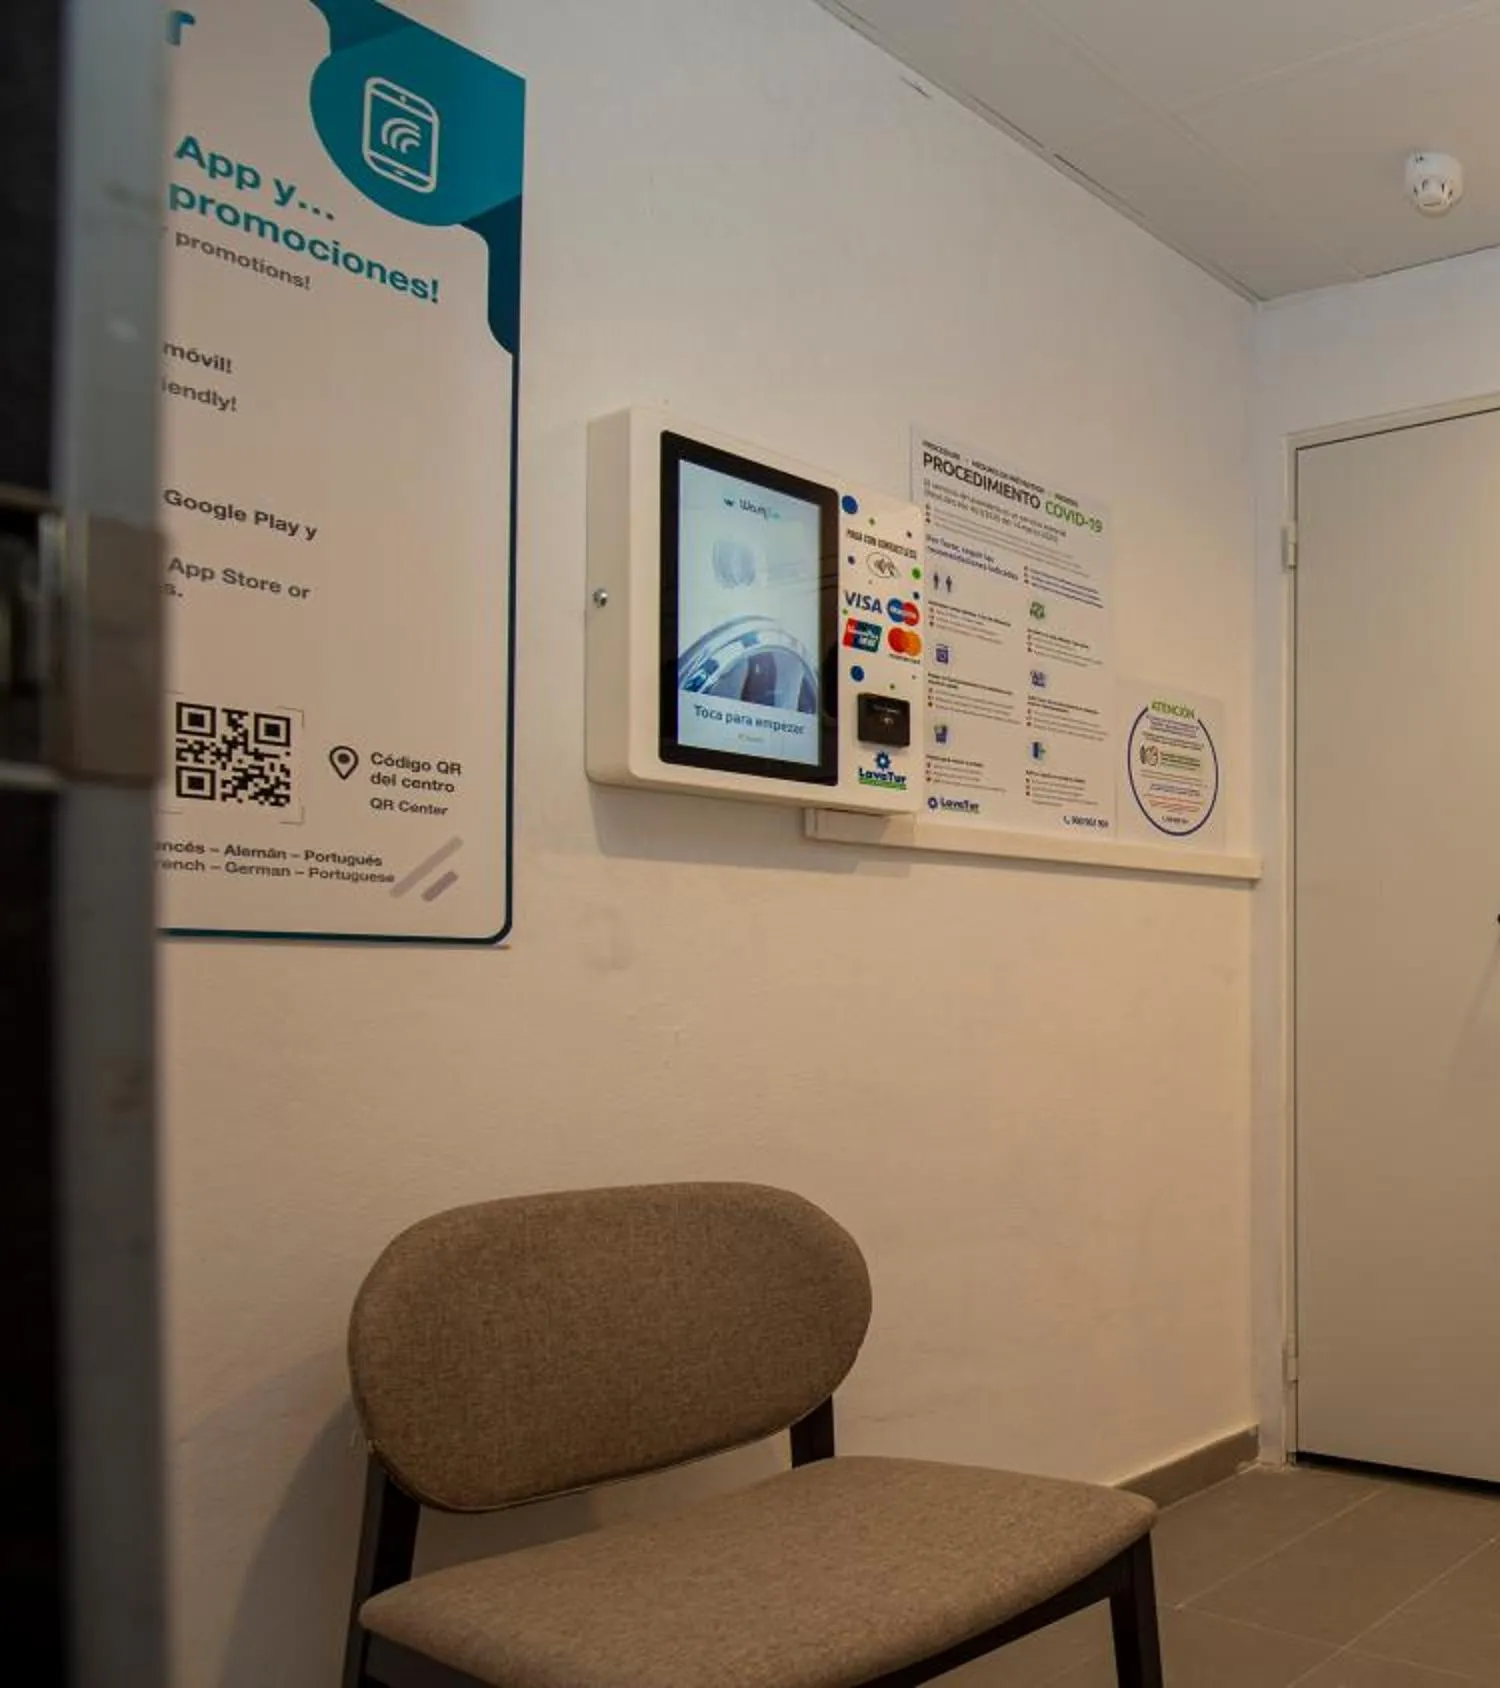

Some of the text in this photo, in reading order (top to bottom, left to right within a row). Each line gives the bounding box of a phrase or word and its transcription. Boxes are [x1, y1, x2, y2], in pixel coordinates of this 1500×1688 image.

[174, 135, 261, 190] App
[169, 183, 439, 303] promociones!
[175, 232, 311, 289] promotions!
[163, 343, 232, 374] móvil!
[923, 451, 1041, 509] PROCEDIMIENTO
[1045, 501, 1104, 533] COVID-19
[164, 489, 318, 541] Google Play y
[168, 557, 312, 600] App Store or
[844, 589, 883, 614] VISA
[693, 704, 805, 736] Toca para empezar
[370, 751, 462, 776] Código QR
[370, 771, 455, 793] del centro
[370, 797, 449, 816] QR Center
[224, 843, 287, 860] Alemán
[303, 849, 383, 868] Portugués
[224, 861, 292, 877] German
[308, 866, 395, 884] Portuguese
